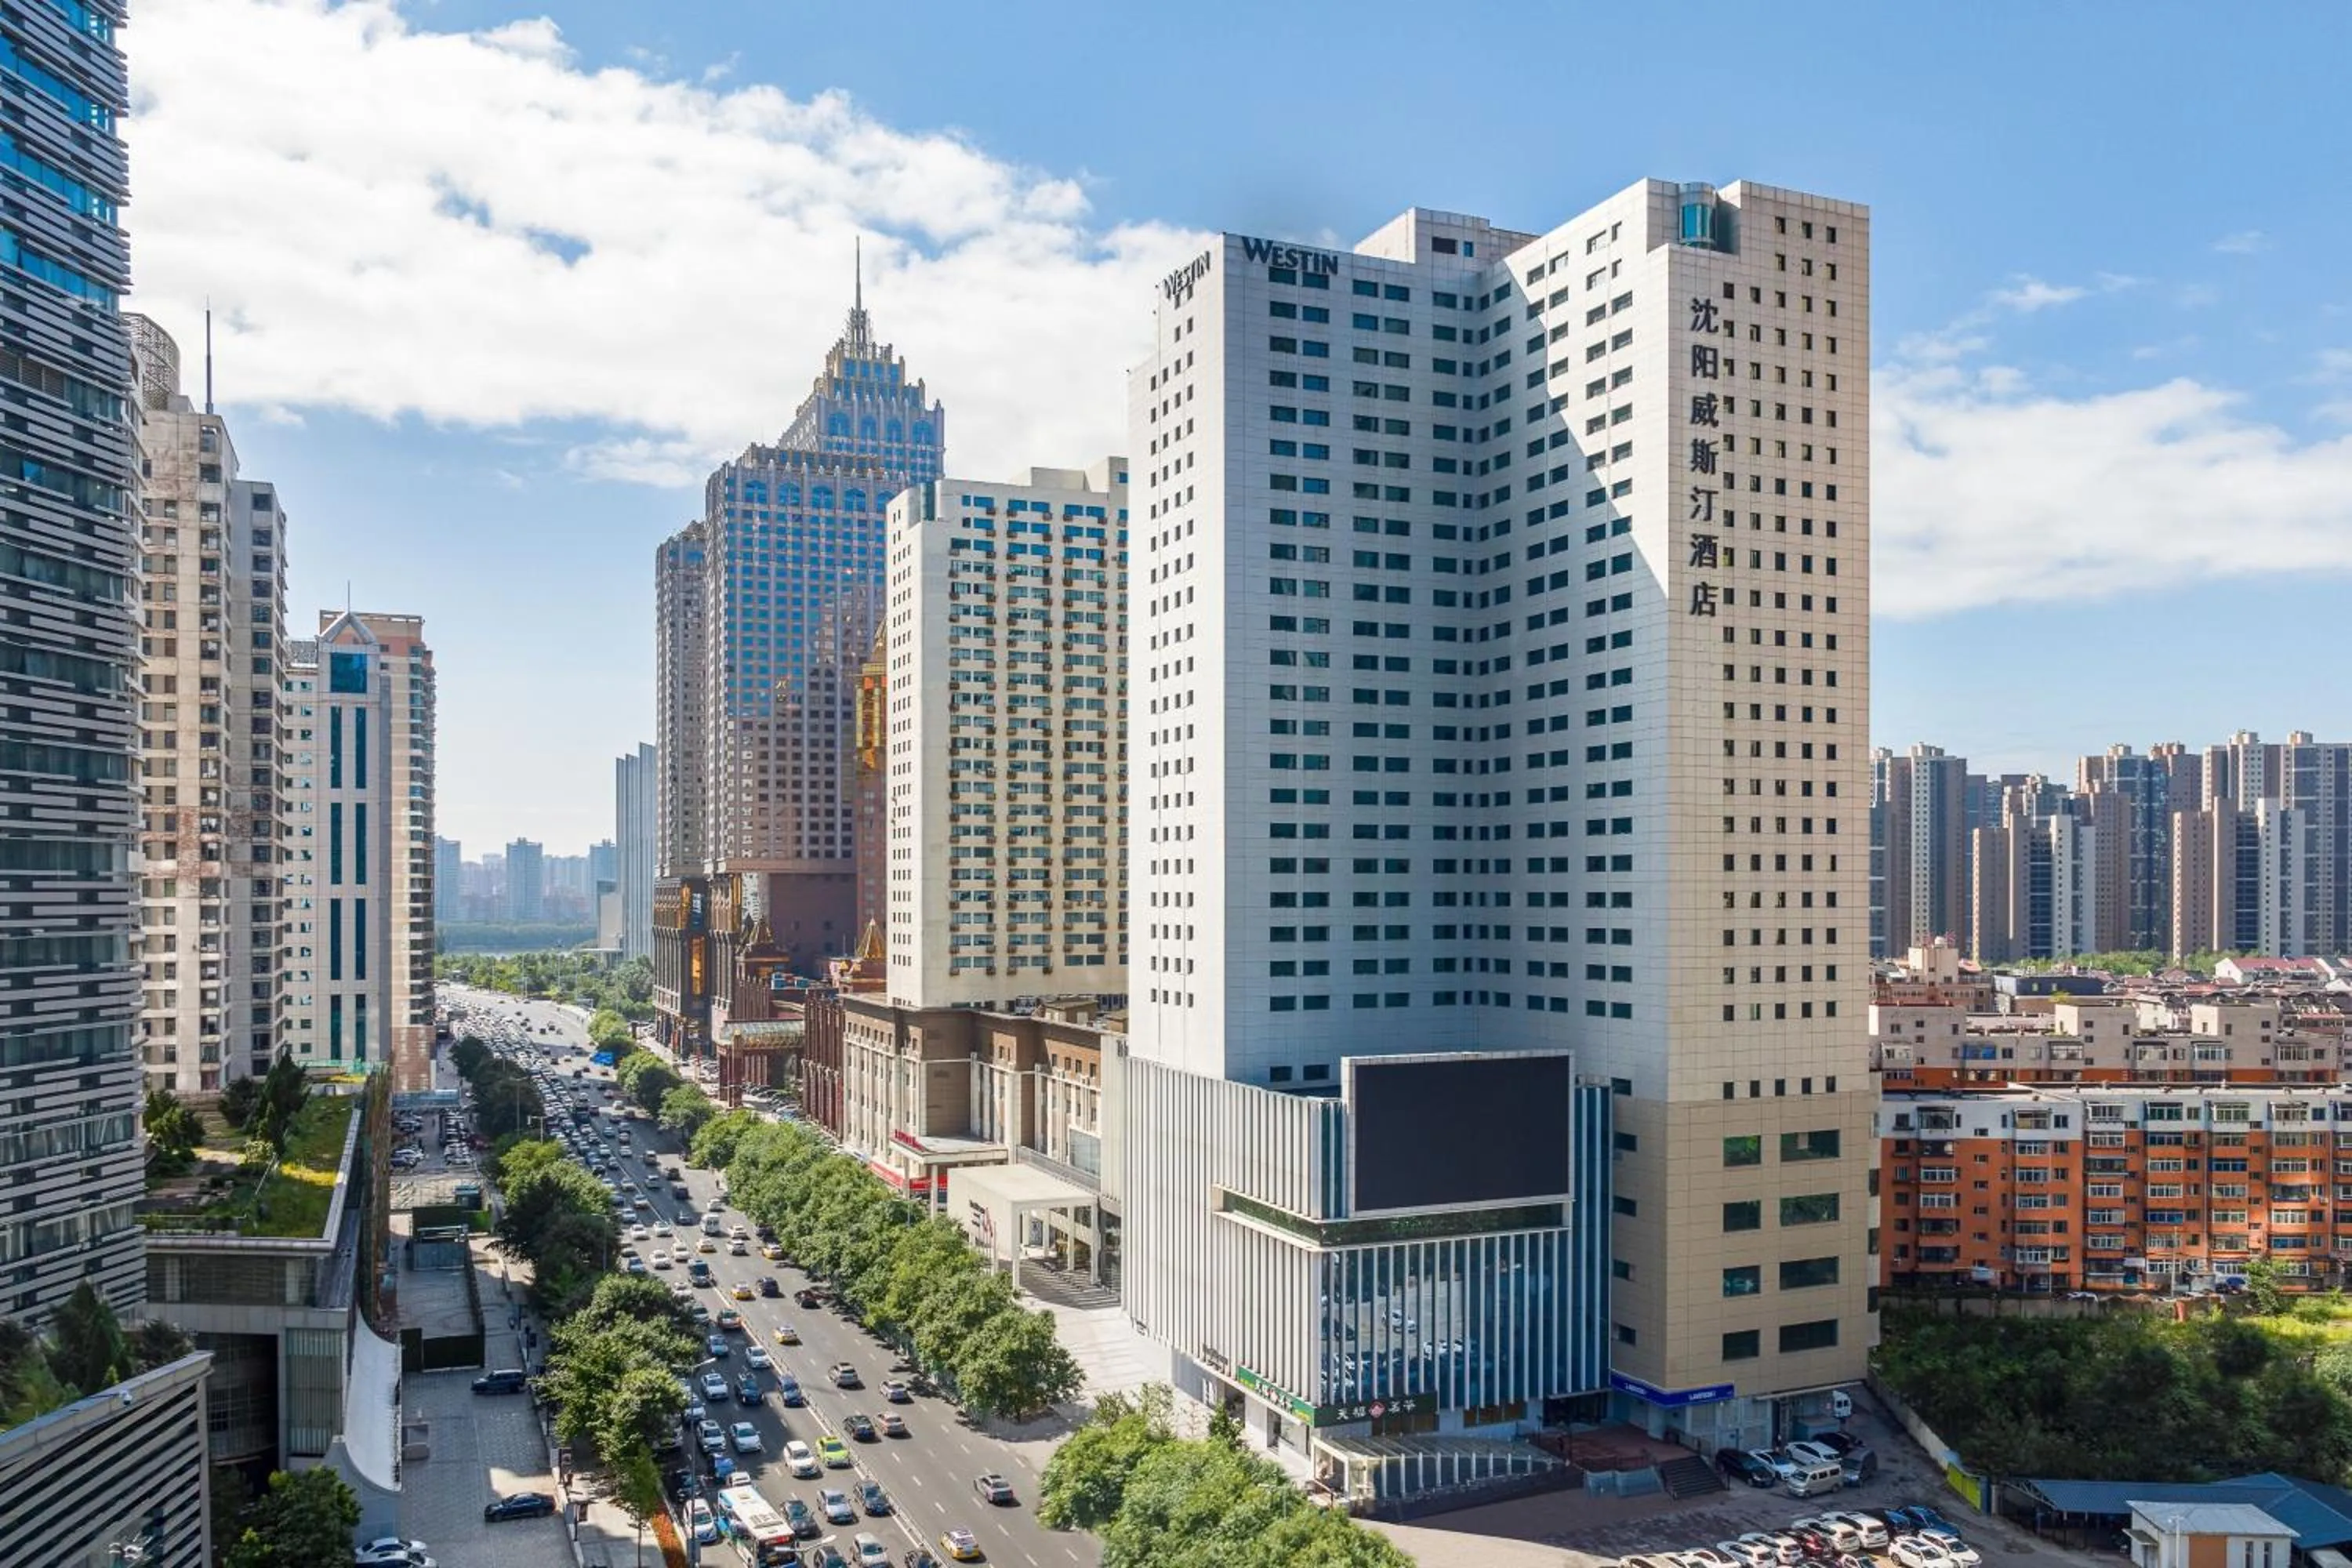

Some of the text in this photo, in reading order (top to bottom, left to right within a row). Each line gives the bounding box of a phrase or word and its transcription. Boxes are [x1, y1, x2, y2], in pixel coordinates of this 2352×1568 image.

[1242, 236, 1338, 275] WESTIN
[1689, 298, 1719, 617] 沈阳威斯汀酒店
